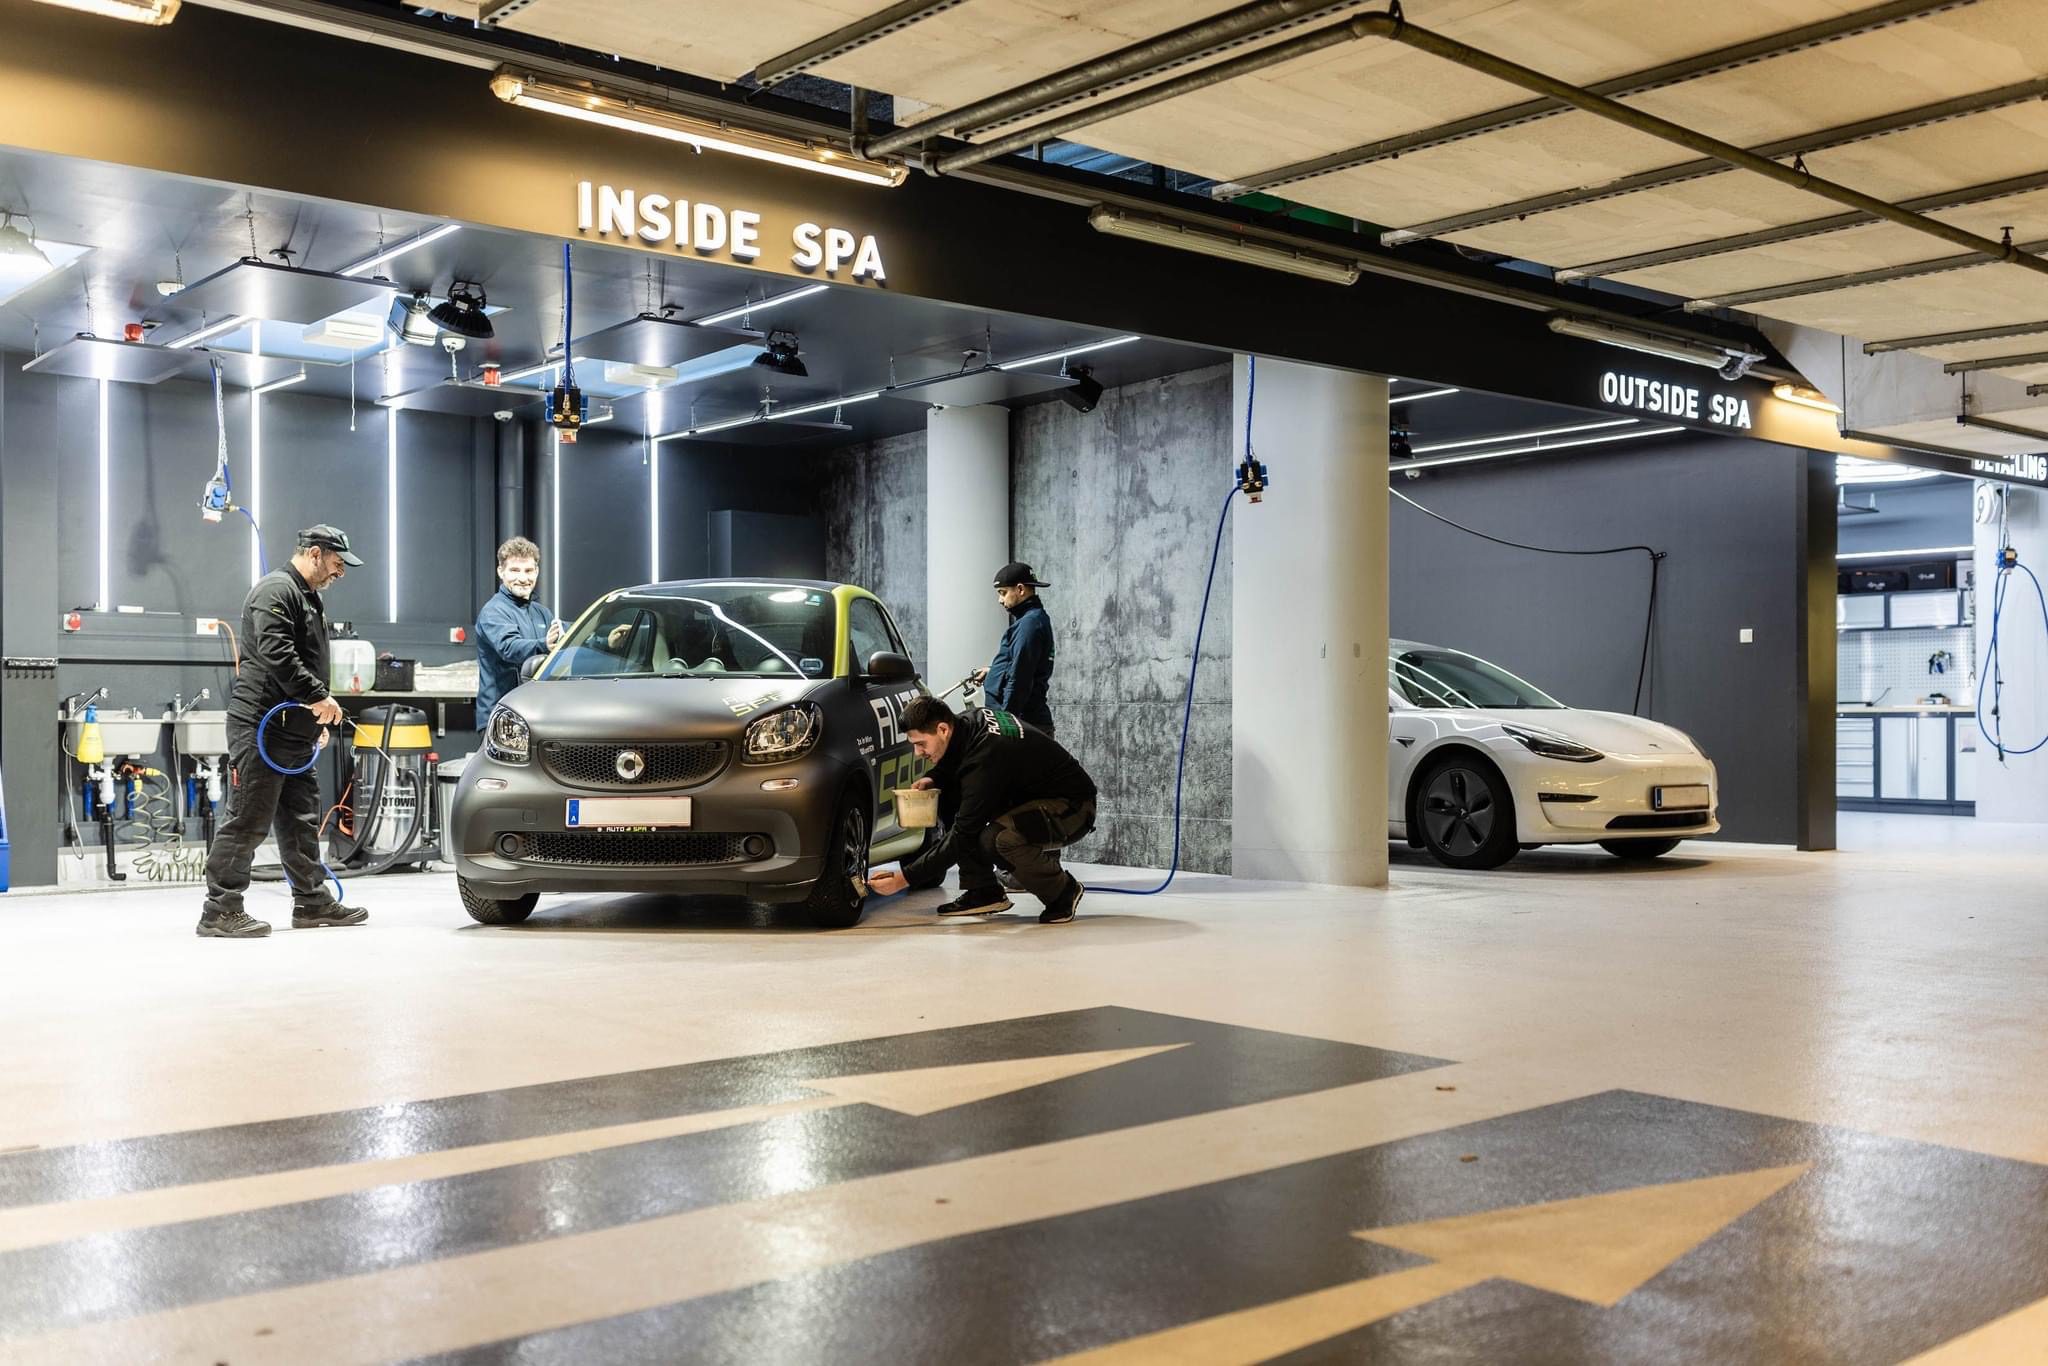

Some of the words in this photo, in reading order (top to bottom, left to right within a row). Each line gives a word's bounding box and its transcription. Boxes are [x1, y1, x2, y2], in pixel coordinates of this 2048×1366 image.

[577, 180, 761, 259] INSIDE
[791, 221, 887, 281] SPA
[1600, 371, 1699, 419] OUTSIDE
[1708, 393, 1752, 429] SPA
[869, 689, 920, 749] AU
[981, 708, 1001, 736] AUTO
